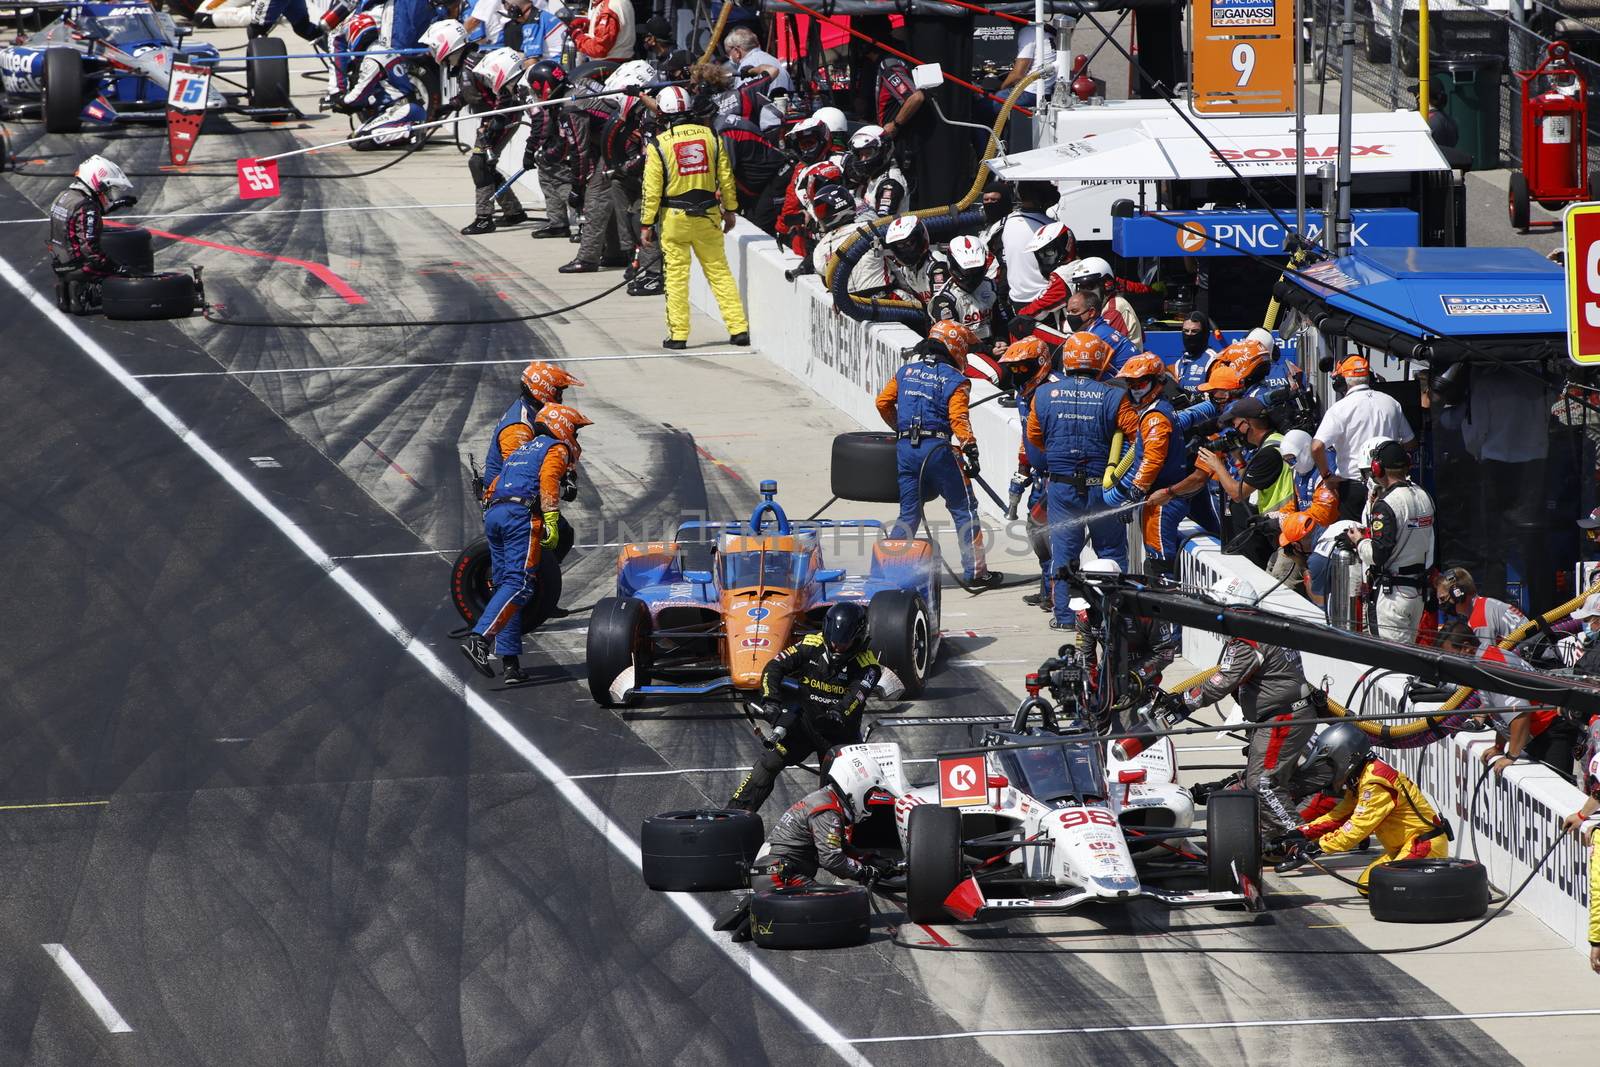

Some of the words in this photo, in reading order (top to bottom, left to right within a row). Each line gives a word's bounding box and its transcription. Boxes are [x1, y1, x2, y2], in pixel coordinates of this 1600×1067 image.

[1224, 8, 1273, 18] GANASSI
[1232, 43, 1256, 87] 9
[173, 79, 205, 103] 15
[1209, 145, 1392, 160] SONAX
[242, 166, 274, 190] 55
[1213, 224, 1279, 249] PNC
[747, 606, 771, 622] 9
[1456, 743, 1469, 822] 98
[1473, 754, 1493, 841] U.S.
[1060, 810, 1117, 829] 98
